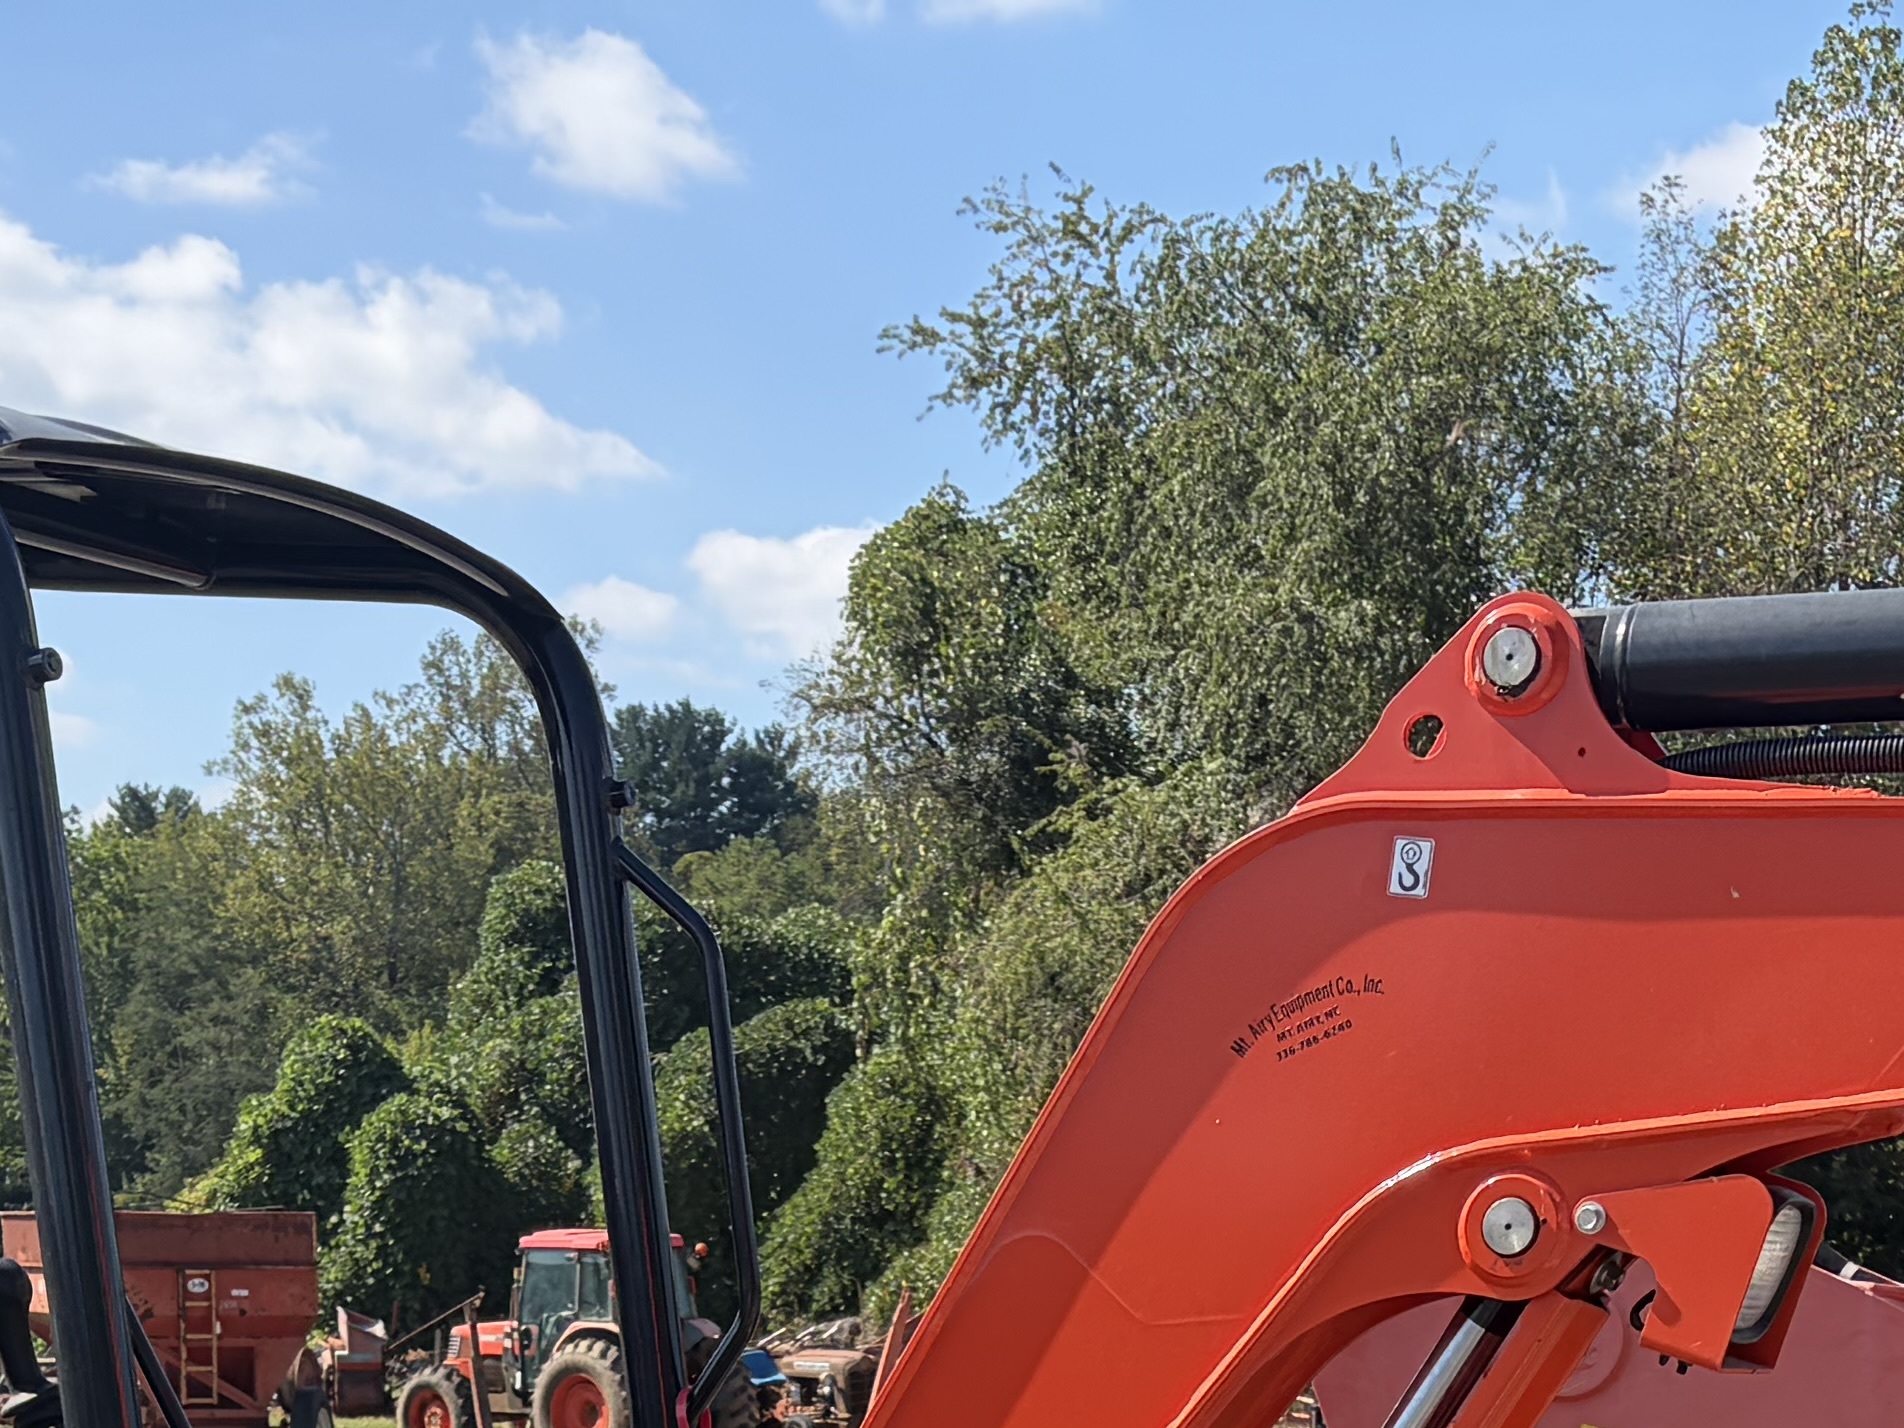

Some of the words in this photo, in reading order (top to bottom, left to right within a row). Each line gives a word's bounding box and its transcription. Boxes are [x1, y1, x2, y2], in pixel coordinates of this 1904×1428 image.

[1230, 1037, 1256, 1058] Mt.
[1248, 1012, 1277, 1040] Airy
[1270, 980, 1335, 1023] Equipment
